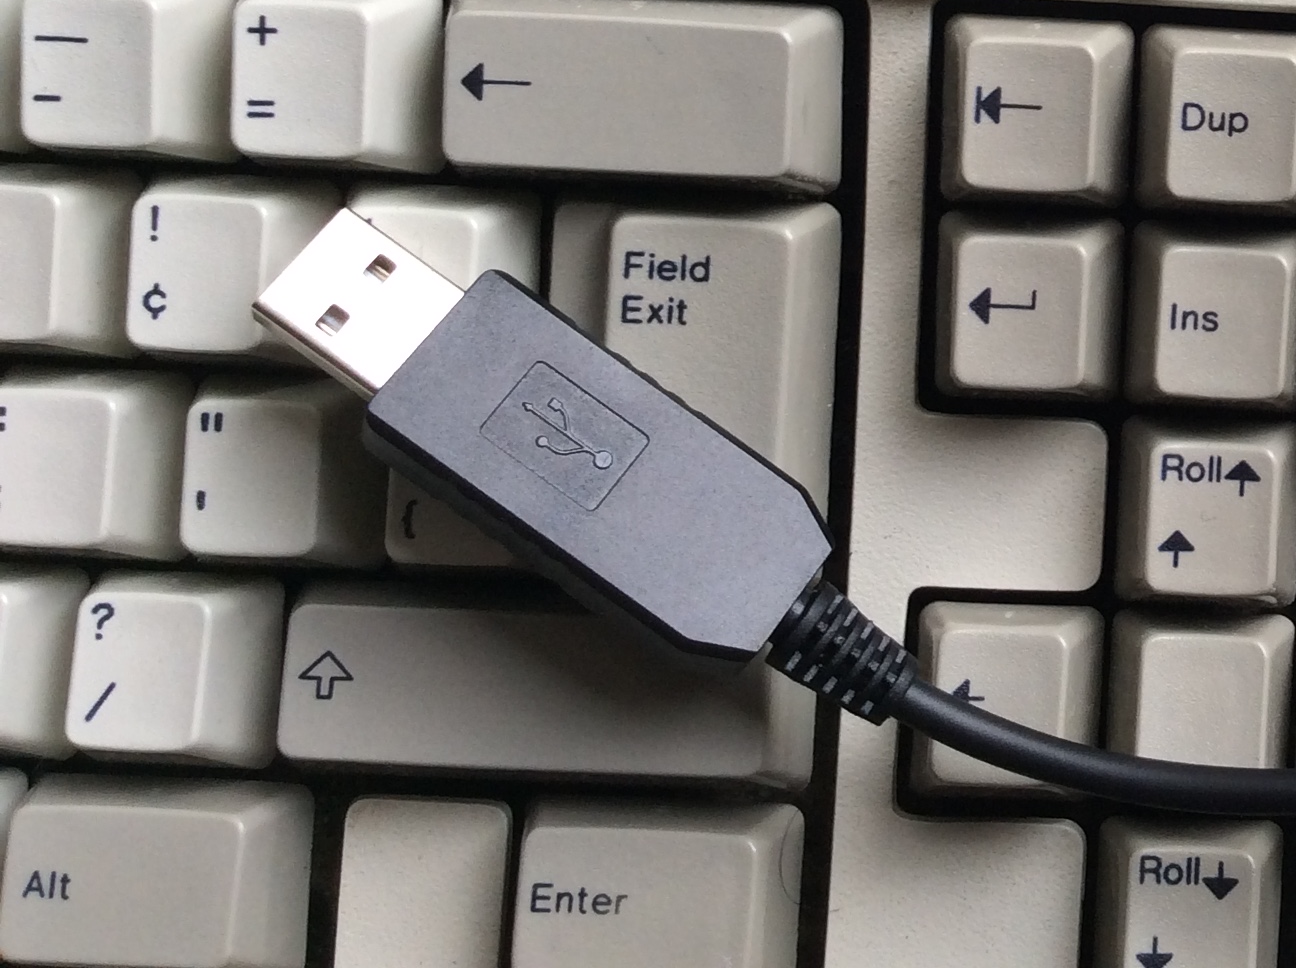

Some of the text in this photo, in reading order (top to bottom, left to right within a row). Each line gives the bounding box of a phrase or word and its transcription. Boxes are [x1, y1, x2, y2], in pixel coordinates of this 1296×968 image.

[1180, 102, 1250, 137] Dup
[149, 205, 161, 243] !
[622, 250, 712, 283] Field
[619, 294, 689, 327] Exit
[1169, 302, 1220, 334] Ins
[1160, 452, 1223, 483] Roll
[90, 601, 116, 640] ?
[84, 681, 117, 723] /
[22, 869, 72, 901] Alt
[1138, 854, 1201, 886] Roll
[529, 881, 629, 915] Enter
